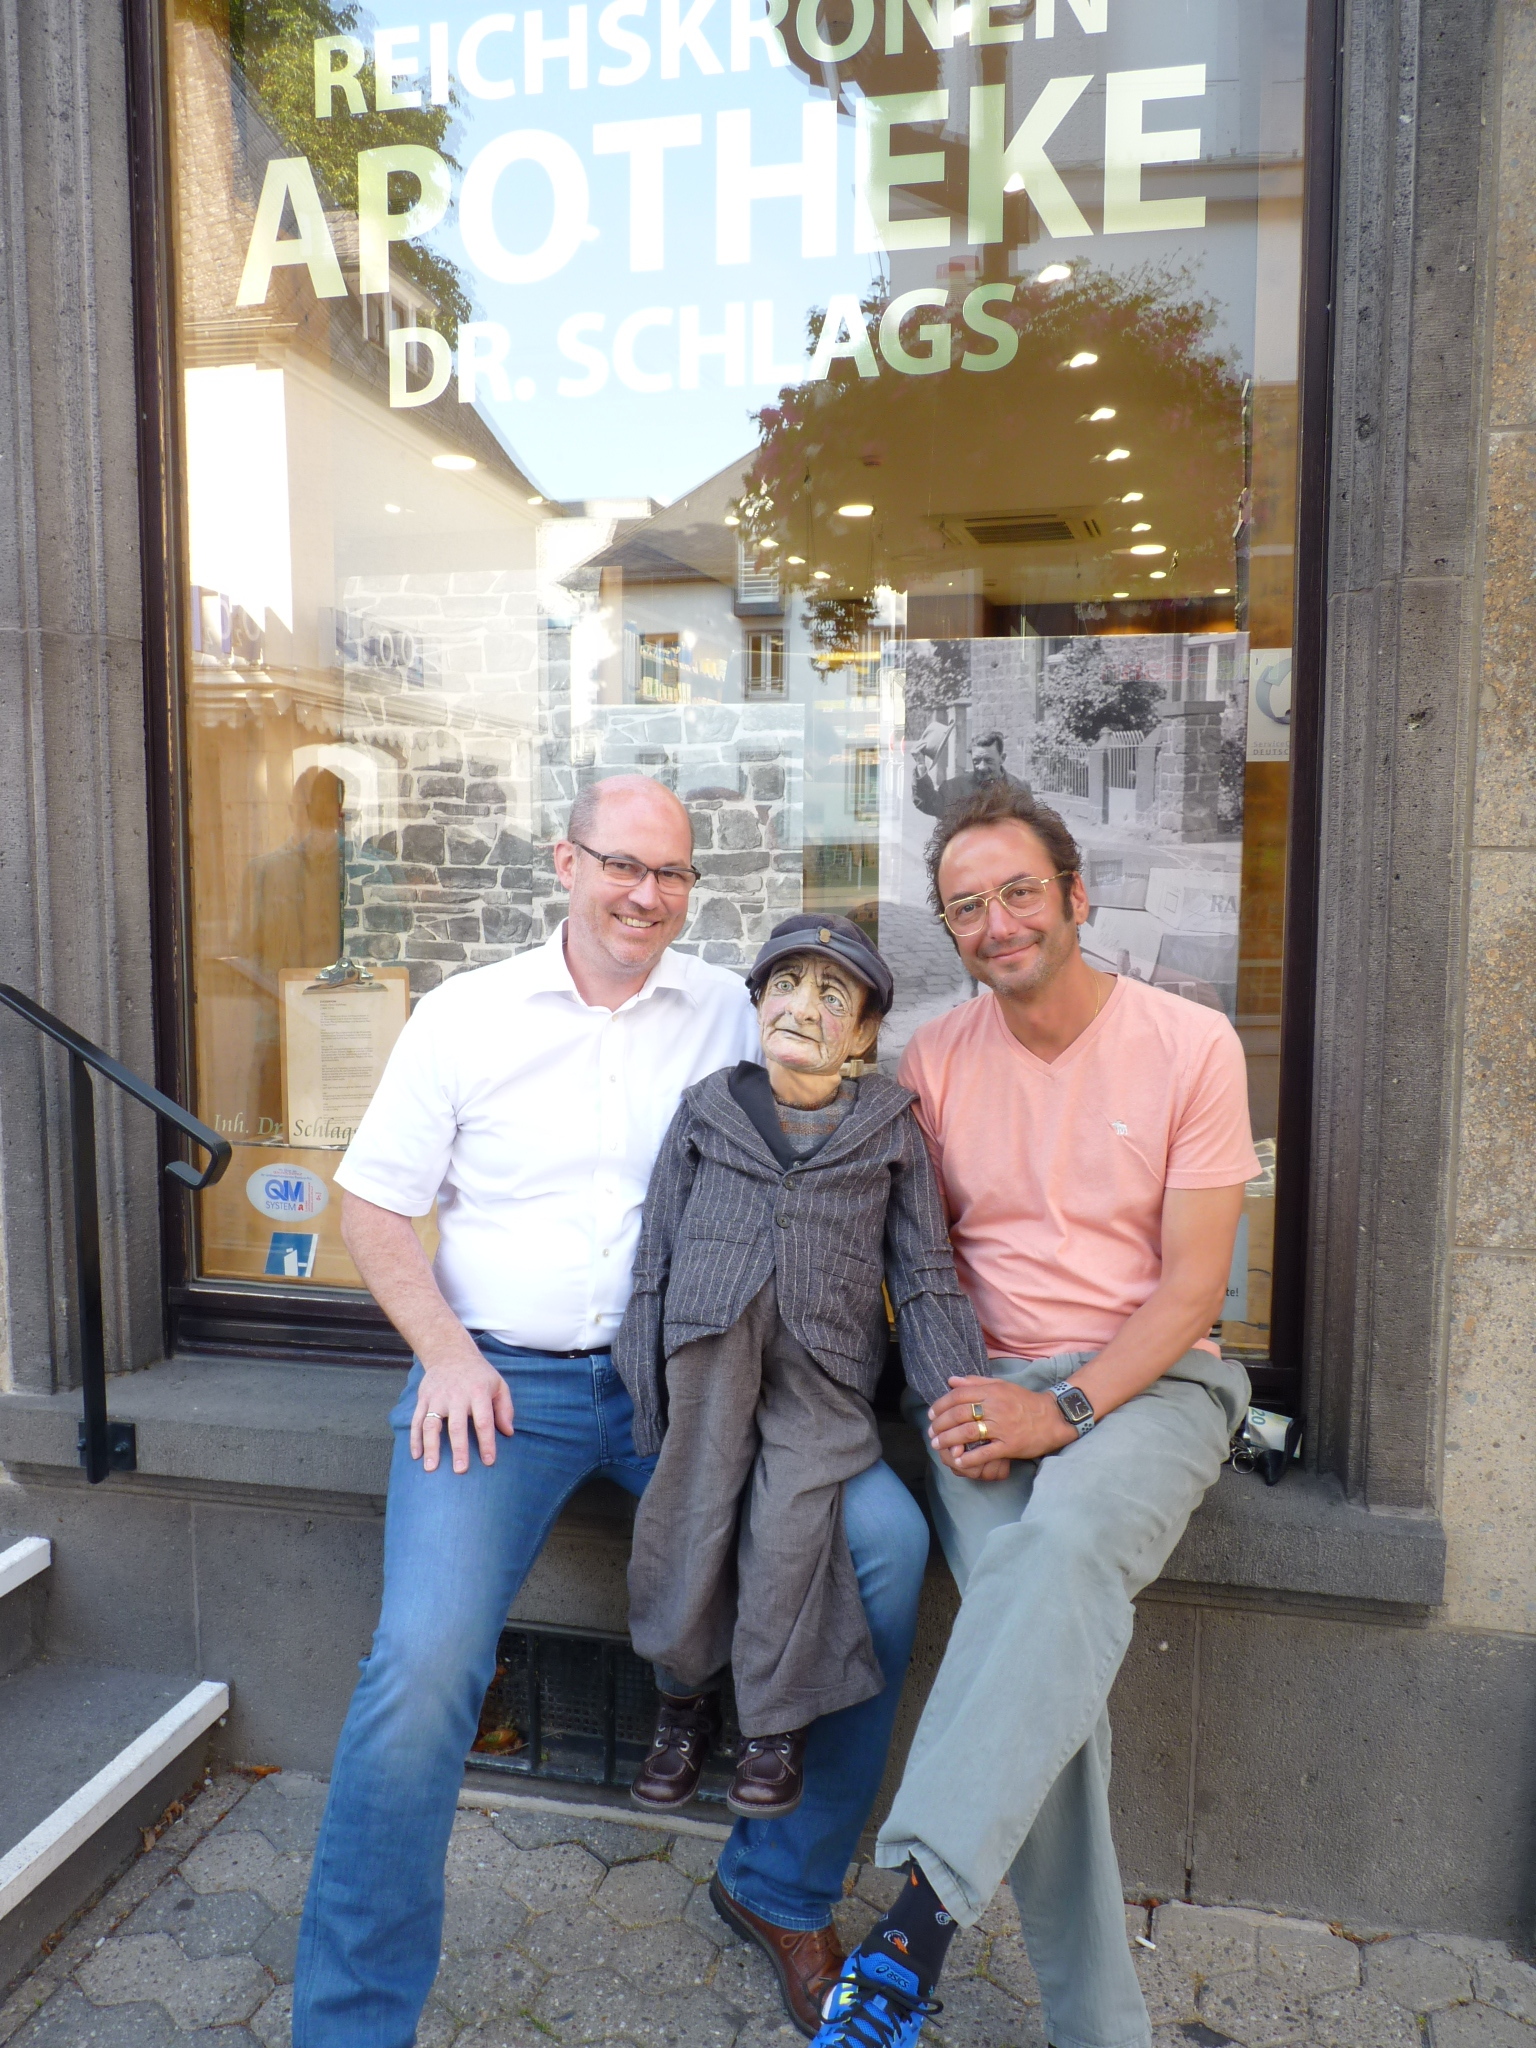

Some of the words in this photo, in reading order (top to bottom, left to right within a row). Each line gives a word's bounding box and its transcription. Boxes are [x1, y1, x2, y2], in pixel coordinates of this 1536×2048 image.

[235, 63, 1207, 307] APOTHEKE
[388, 321, 537, 409] DR.
[556, 283, 1019, 397] SCHLAGS
[214, 1112, 249, 1134] Inh.
[264, 1179, 305, 1203] QM
[266, 1201, 296, 1212] SYSTEM
[1251, 1408, 1266, 1426] 20
